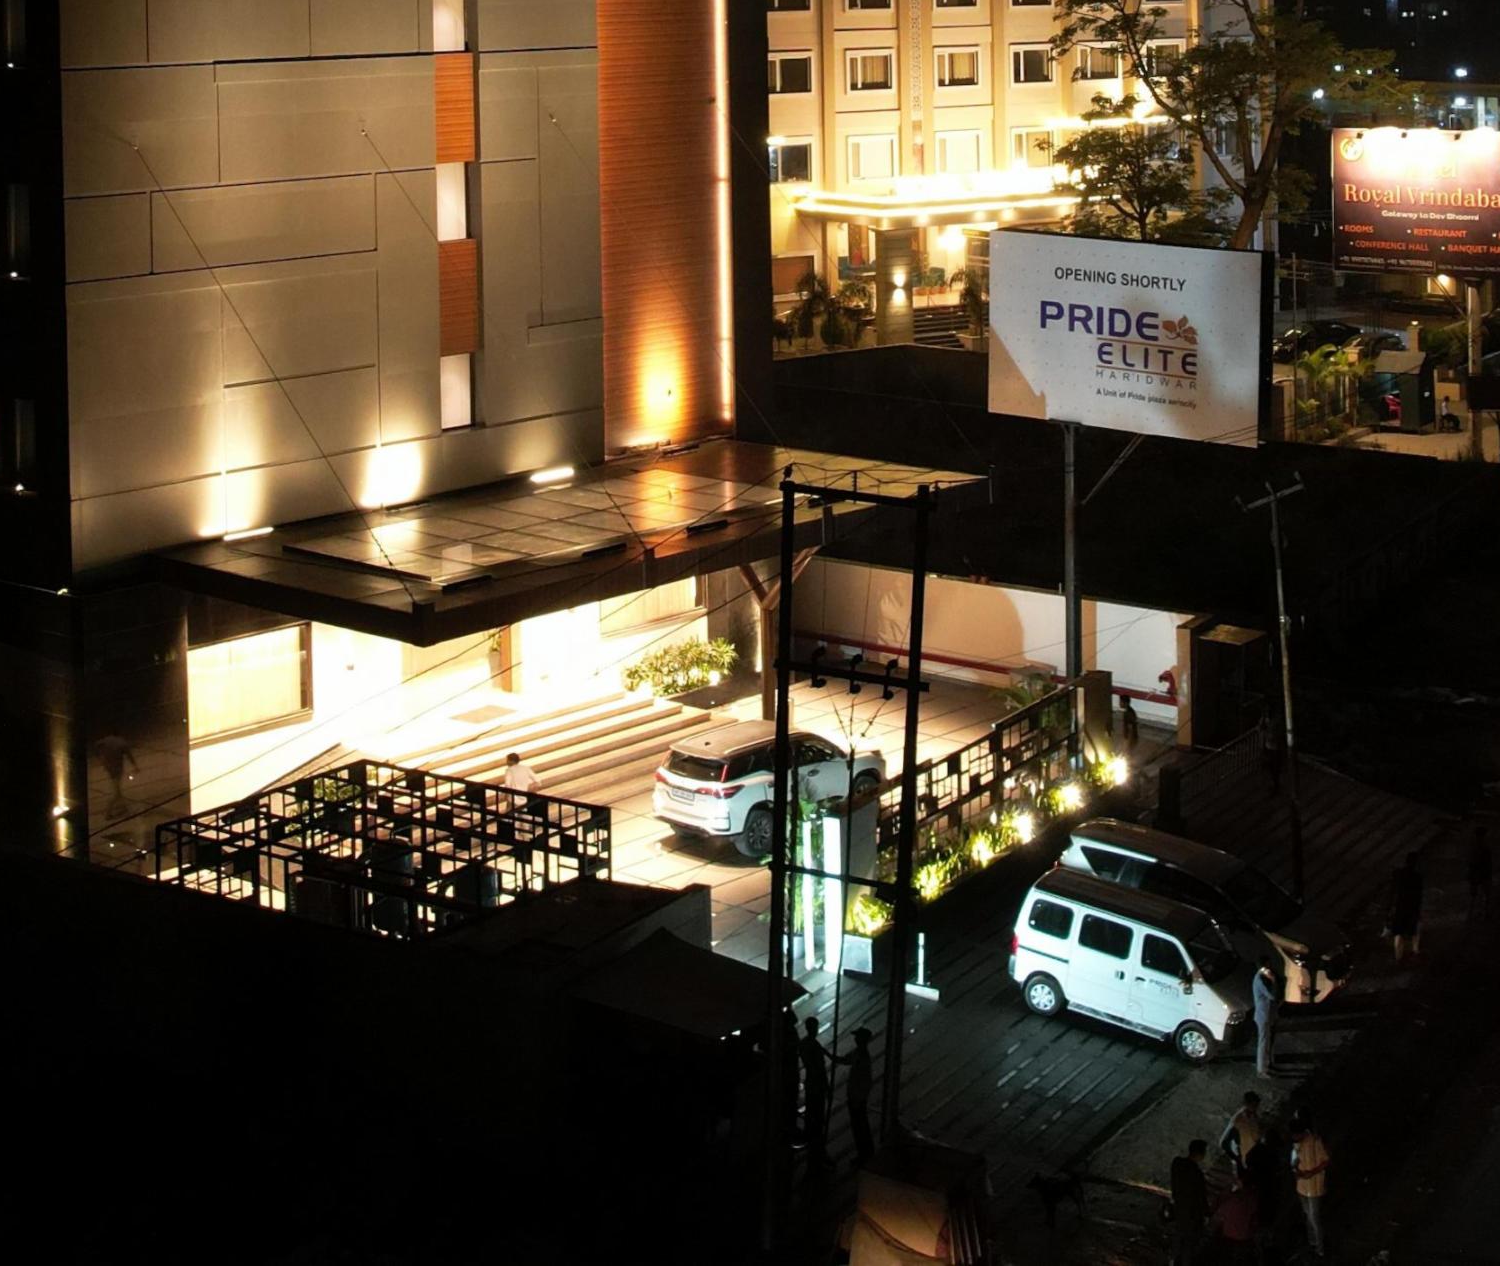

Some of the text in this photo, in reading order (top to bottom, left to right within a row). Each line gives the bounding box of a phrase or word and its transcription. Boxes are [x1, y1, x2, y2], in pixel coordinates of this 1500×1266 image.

[1343, 183, 1402, 209] Royal
[1344, 224, 1375, 234] ROOMS
[1413, 228, 1468, 239] RESTAURANT
[1354, 240, 1430, 252] CONFERENCE HALL
[1447, 245, 1488, 255] BANQUET
[1054, 266, 1186, 292] OPENING SHORTLY
[1039, 300, 1159, 342] PRIDE
[1097, 342, 1198, 376] ELITE
[1095, 369, 1197, 391] HARIDWAR
[1103, 388, 1117, 398] Unit
[1119, 390, 1127, 399] of
[1128, 391, 1146, 402] Pride
